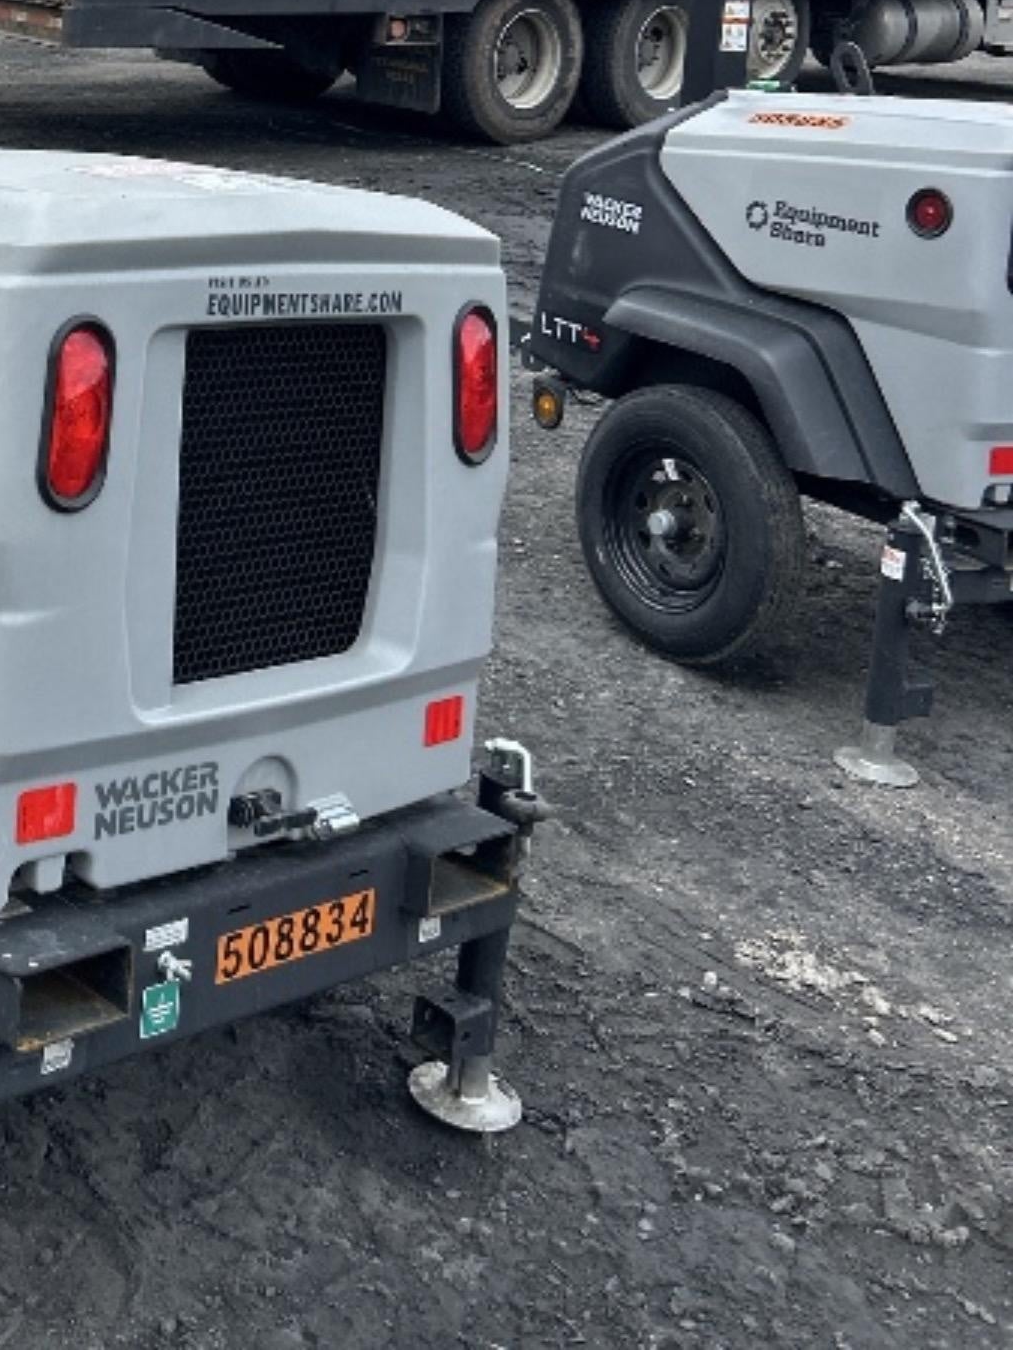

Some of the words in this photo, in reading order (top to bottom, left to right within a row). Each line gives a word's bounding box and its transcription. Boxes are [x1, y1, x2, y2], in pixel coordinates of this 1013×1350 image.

[770, 221, 826, 247] Share
[773, 200, 881, 238] Equipment
[206, 291, 403, 317] EQUIPMENTSHARE.COM
[94, 761, 219, 810] WACKER
[94, 789, 219, 840] NEUSON
[221, 893, 369, 979] 508834
